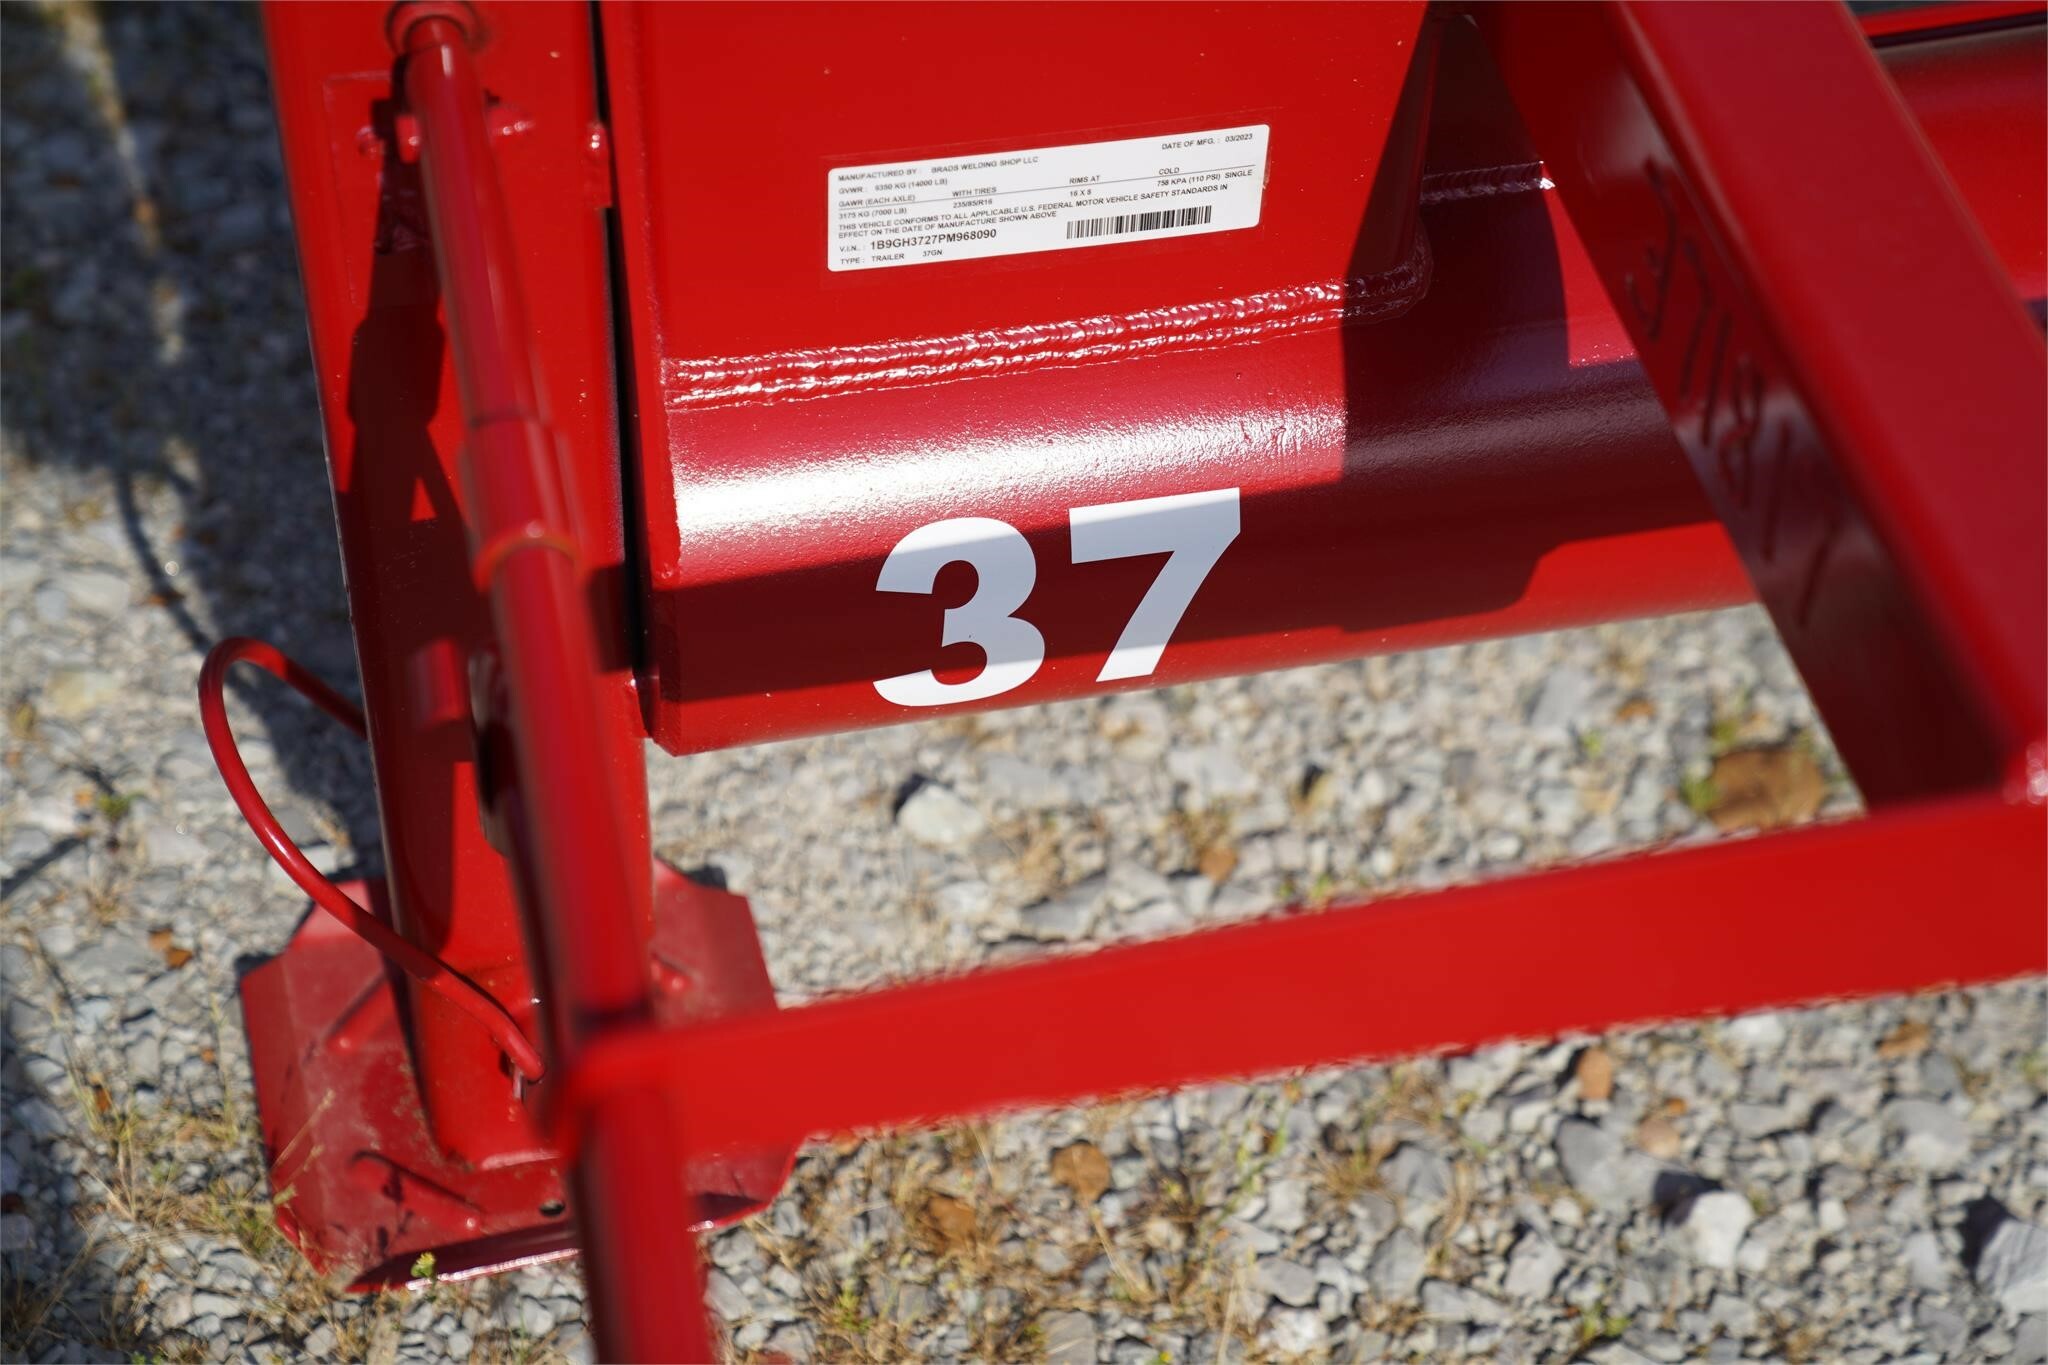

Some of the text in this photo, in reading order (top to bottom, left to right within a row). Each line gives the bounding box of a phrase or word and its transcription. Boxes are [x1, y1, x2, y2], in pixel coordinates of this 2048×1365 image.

[1161, 140, 1182, 149] DATE
[1196, 137, 1215, 145] MFG.
[1225, 133, 1252, 142] 03/2023
[838, 169, 904, 182] MANUFACTURED
[931, 163, 958, 172] BRADS
[961, 160, 997, 169] WELDING
[999, 157, 1021, 166] SHOP
[1023, 155, 1038, 163] LLC
[1158, 166, 1179, 174] COLD
[1069, 175, 1088, 184] RIMS
[1171, 176, 1186, 184] KPA
[1188, 175, 1204, 183] (110
[1206, 173, 1220, 181] PSI)
[1224, 169, 1252, 178] SINGLE
[838, 186, 862, 195] GVWR
[909, 179, 932, 188] (14000
[974, 186, 996, 194] TIRES
[838, 194, 915, 208] GAWR (EACH AXLE)
[858, 219, 890, 229] VEHICLE
[893, 215, 938, 225] CONFORMS
[970, 207, 1018, 217] APPLICABLE
[1037, 201, 1072, 210] FEDERAL
[1075, 197, 1104, 206] MOTOR
[1106, 194, 1138, 203] VEHICLE
[1140, 190, 1168, 199] SAFETY
[1171, 185, 1218, 196] STANDARDS
[858, 210, 869, 218] KG
[871, 208, 891, 216] (7000
[893, 206, 906, 214] LB)
[838, 230, 867, 239] EFFECT
[885, 226, 899, 234] THE
[901, 224, 922, 232] DATE
[937, 217, 996, 229] MANUFACTURE
[999, 213, 1027, 222] SHOWN
[1029, 211, 1056, 219] ABOVE
[870, 228, 996, 250] 1B9GH3727PM968090
[840, 257, 860, 265] TYPE
[871, 253, 904, 262] TRAILER
[873, 487, 1241, 707] 37
